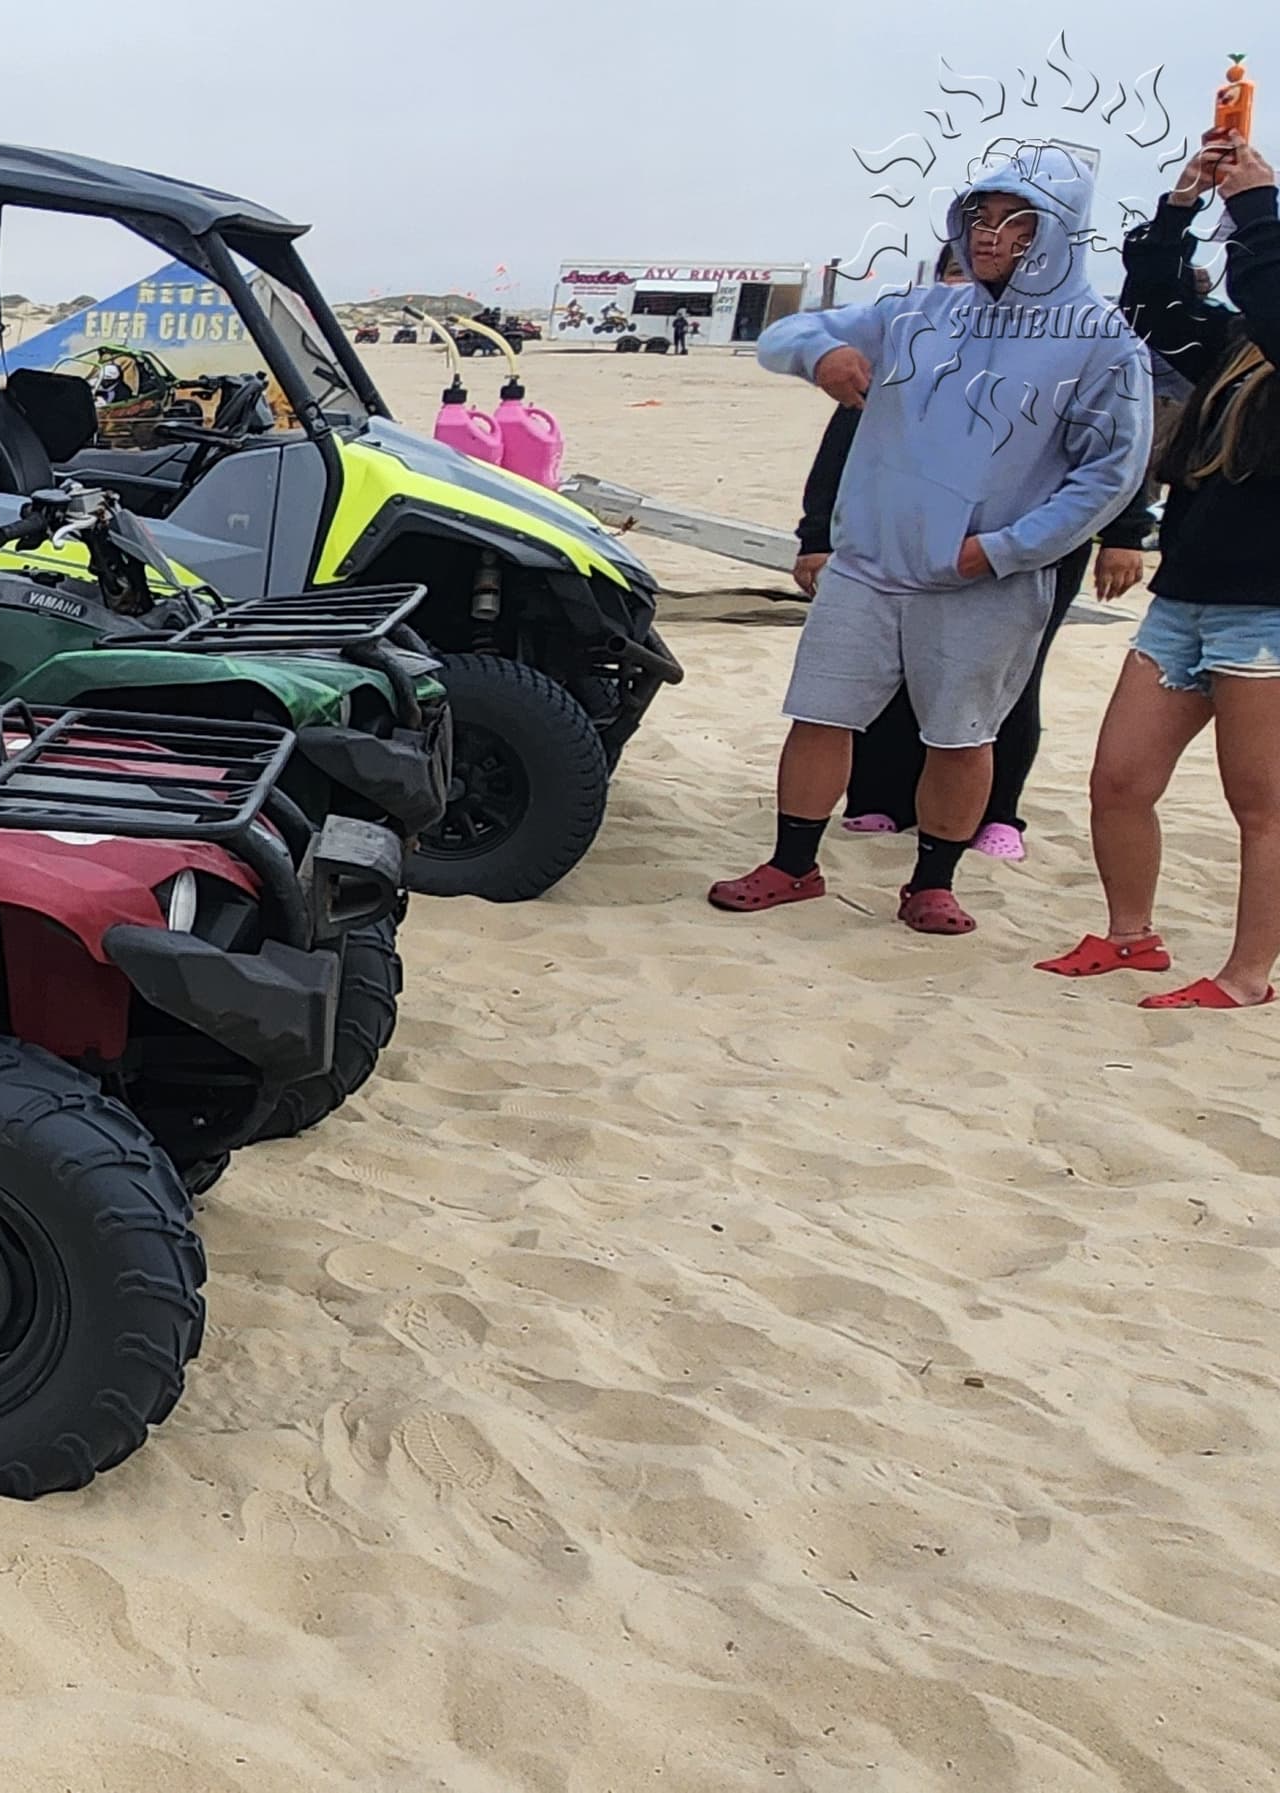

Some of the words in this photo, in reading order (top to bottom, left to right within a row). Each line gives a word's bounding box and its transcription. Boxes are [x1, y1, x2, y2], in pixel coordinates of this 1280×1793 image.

[643, 267, 678, 280] ATV
[689, 269, 771, 281] RENTALS
[85, 311, 148, 340] EVER
[28, 591, 82, 617] YAMAHA
